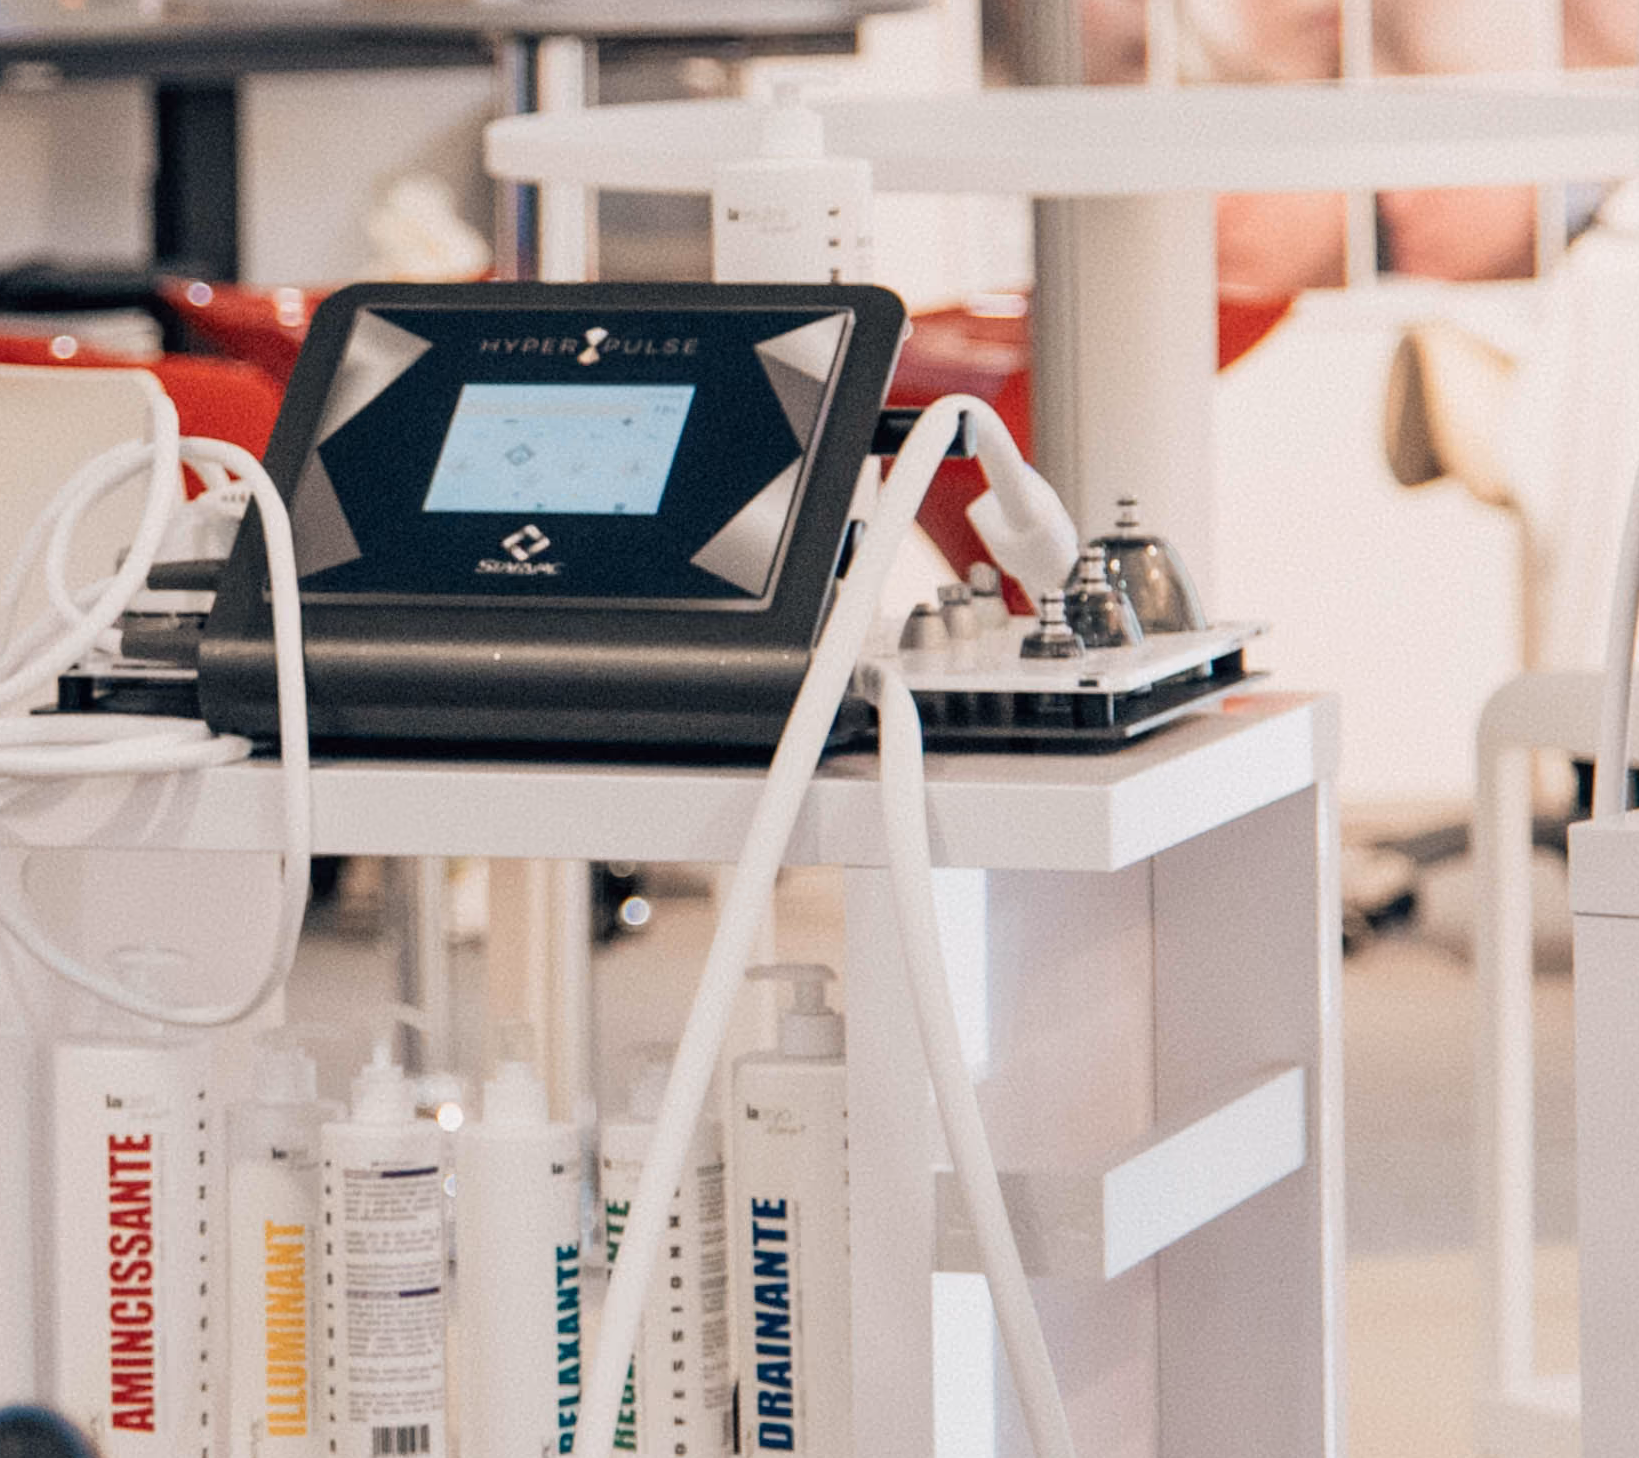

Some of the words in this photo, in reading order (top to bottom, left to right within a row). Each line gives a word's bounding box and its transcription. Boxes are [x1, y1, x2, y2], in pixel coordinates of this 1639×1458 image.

[480, 337, 578, 355] HYPER
[603, 337, 698, 355] PULSE
[106, 1133, 156, 1433] AMINCISSANTE
[264, 1219, 307, 1437] ILLUMINANT
[751, 1197, 795, 1452] DRAINANTE
